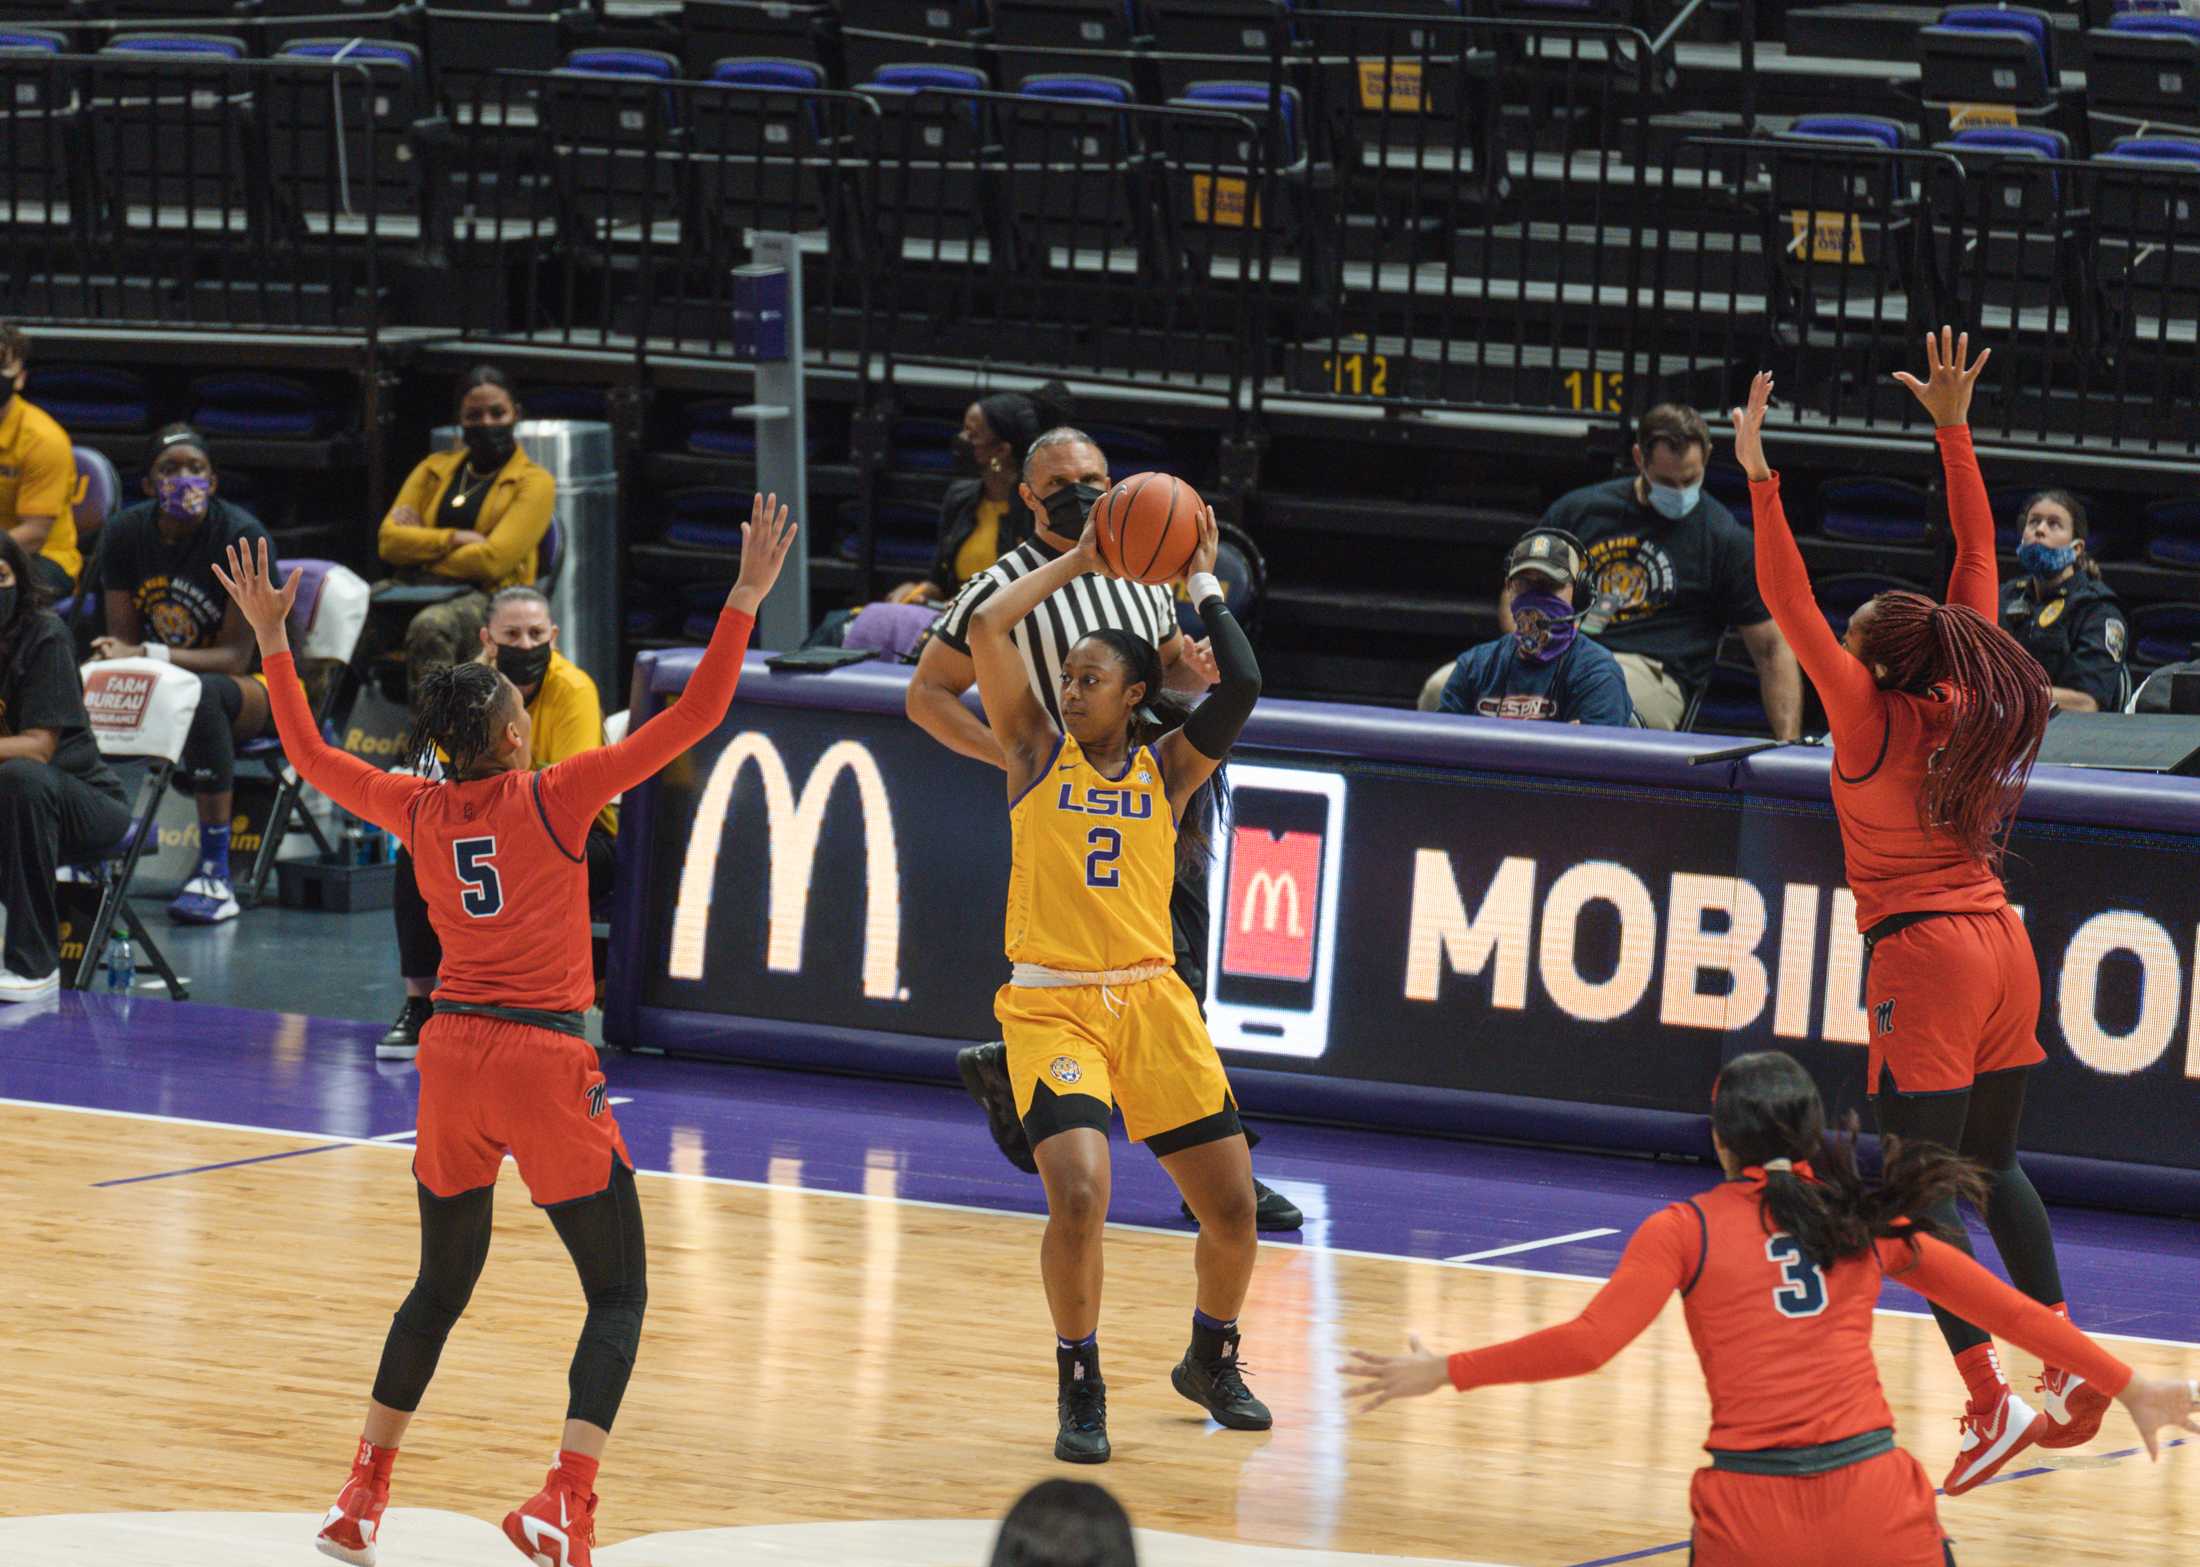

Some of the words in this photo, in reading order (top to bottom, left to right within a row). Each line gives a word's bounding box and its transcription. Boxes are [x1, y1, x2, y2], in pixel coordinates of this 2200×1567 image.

[1322, 353, 1387, 396] 112
[85, 691, 145, 709] BUREAU
[106, 675, 149, 692] FARM
[1056, 783, 1152, 820] LSU
[452, 835, 504, 918] 5
[1085, 825, 1122, 888] 2
[1404, 847, 2024, 1046] MOBIL
[2058, 907, 2200, 1081] O
[1765, 1232, 1830, 1318] 3
